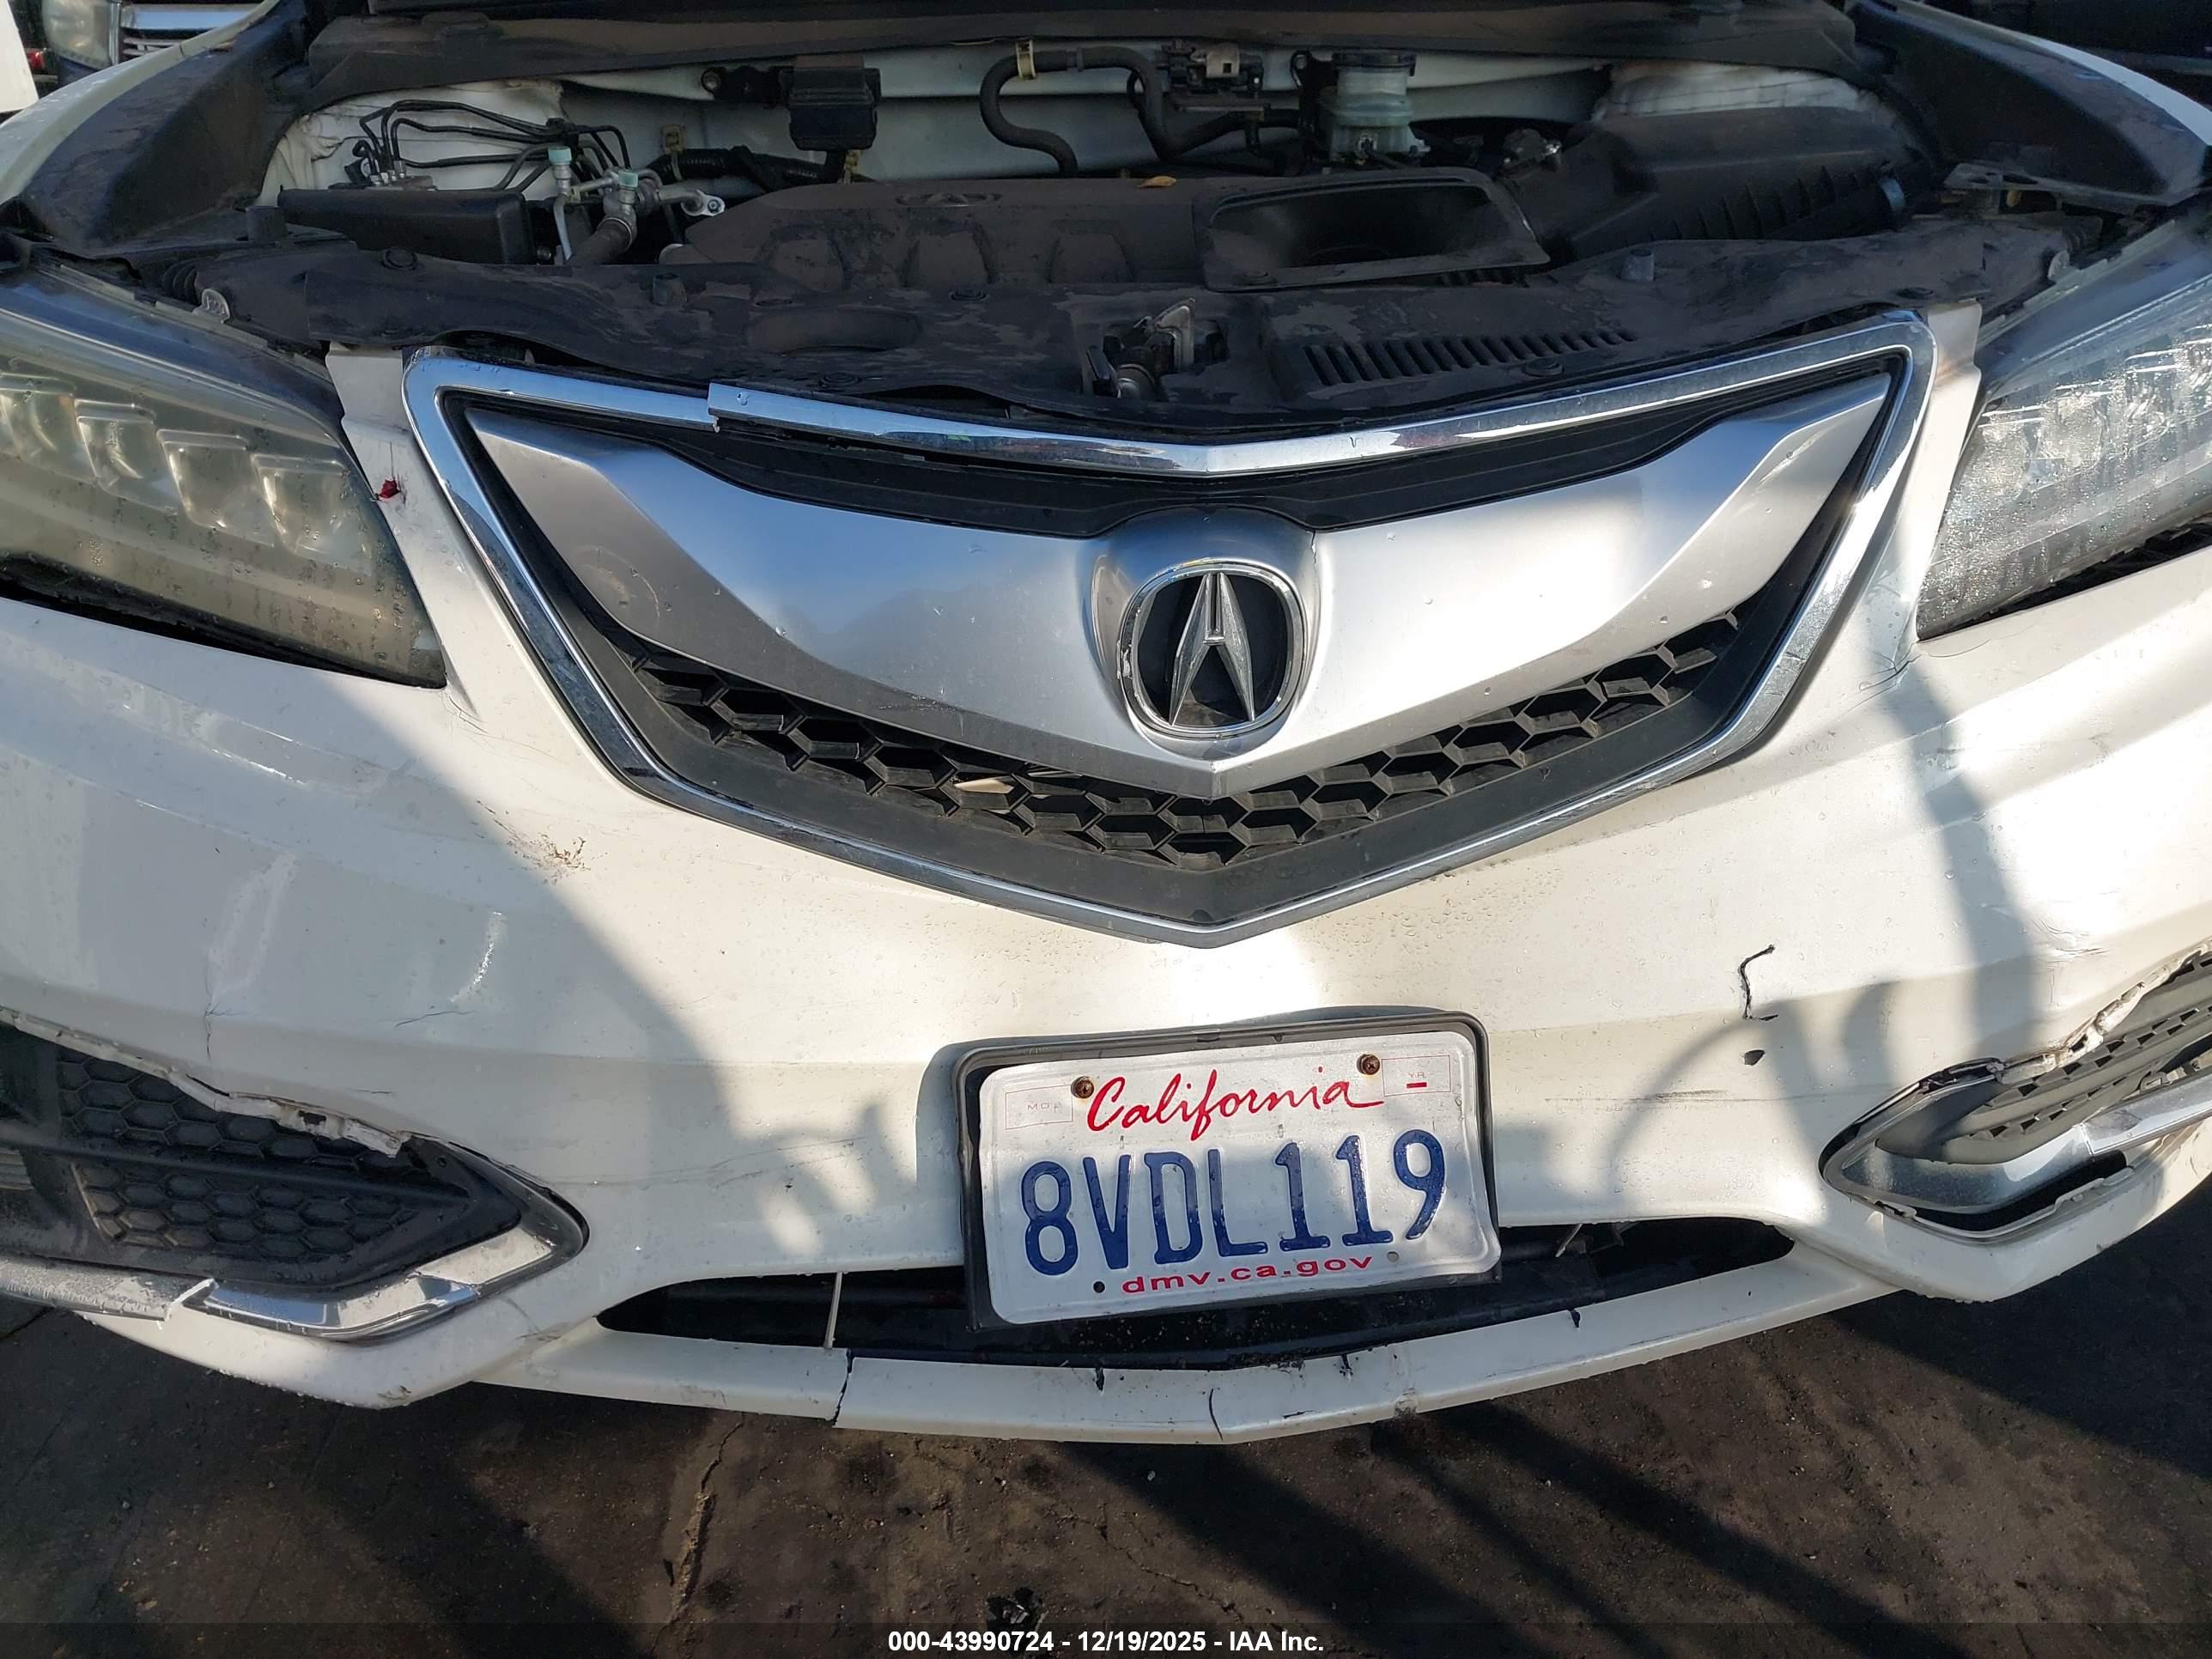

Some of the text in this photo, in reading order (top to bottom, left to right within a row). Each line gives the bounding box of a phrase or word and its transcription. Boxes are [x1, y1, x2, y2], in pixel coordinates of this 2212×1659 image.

[1087, 1066, 1384, 1141] California
[1021, 1129, 1446, 1276] 8VDL119
[1121, 1256, 1373, 1293] dmv.ca.gov
